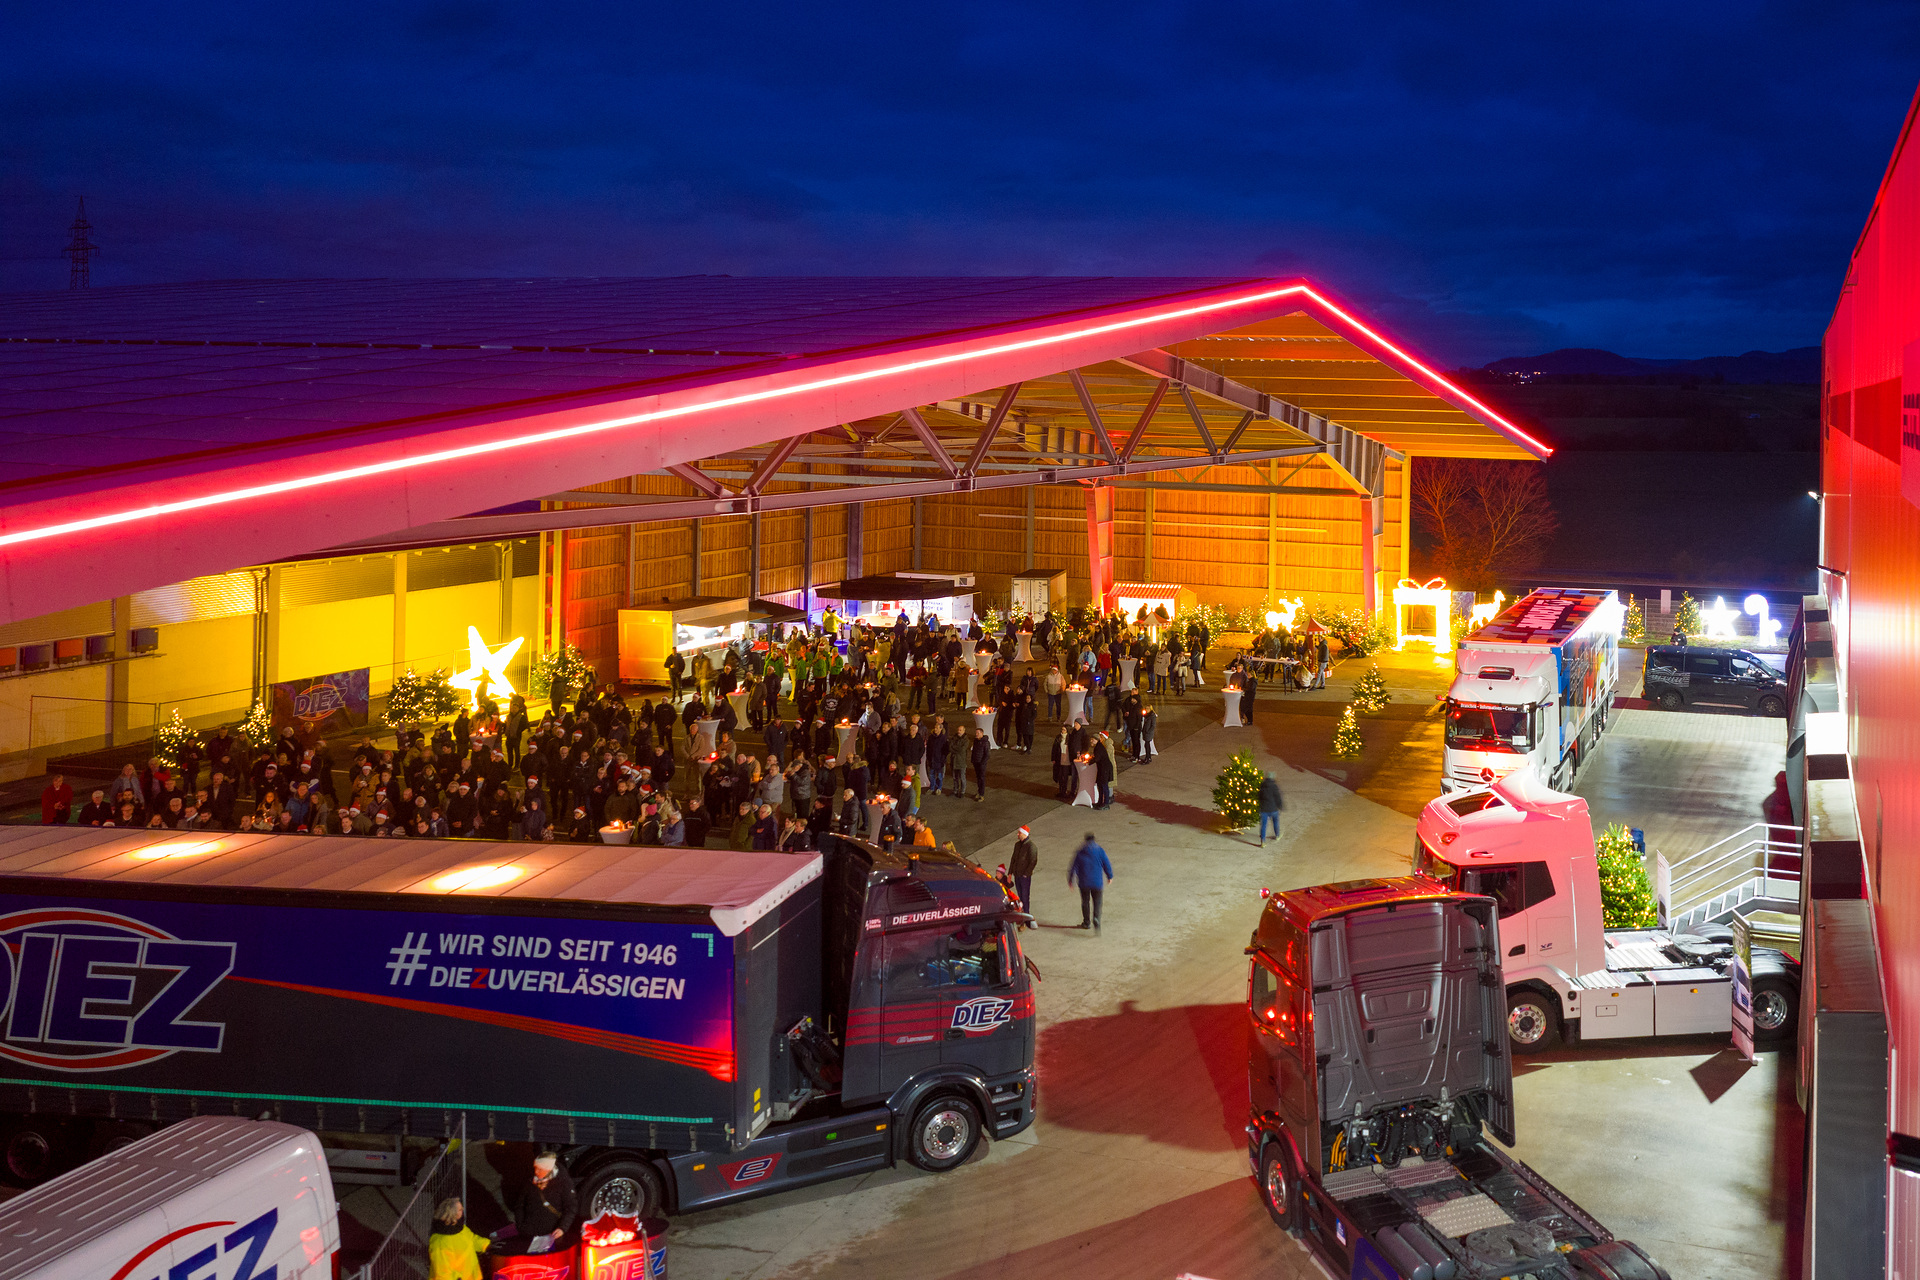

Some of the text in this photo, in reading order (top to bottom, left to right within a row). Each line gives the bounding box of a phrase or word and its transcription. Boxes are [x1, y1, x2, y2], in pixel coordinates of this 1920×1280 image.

[293, 687, 348, 717] DIEZ
[892, 905, 981, 926] DIEZUVERLÄSSIGEN
[439, 933, 484, 955] WIR
[491, 935, 552, 959] SIND
[558, 938, 614, 962] SEIT
[620, 942, 677, 966] 1946
[0, 932, 237, 1053] IEZ
[429, 966, 686, 1000] DIEZUVERLÄSSIGEN
[951, 999, 1014, 1028] DIEZ
